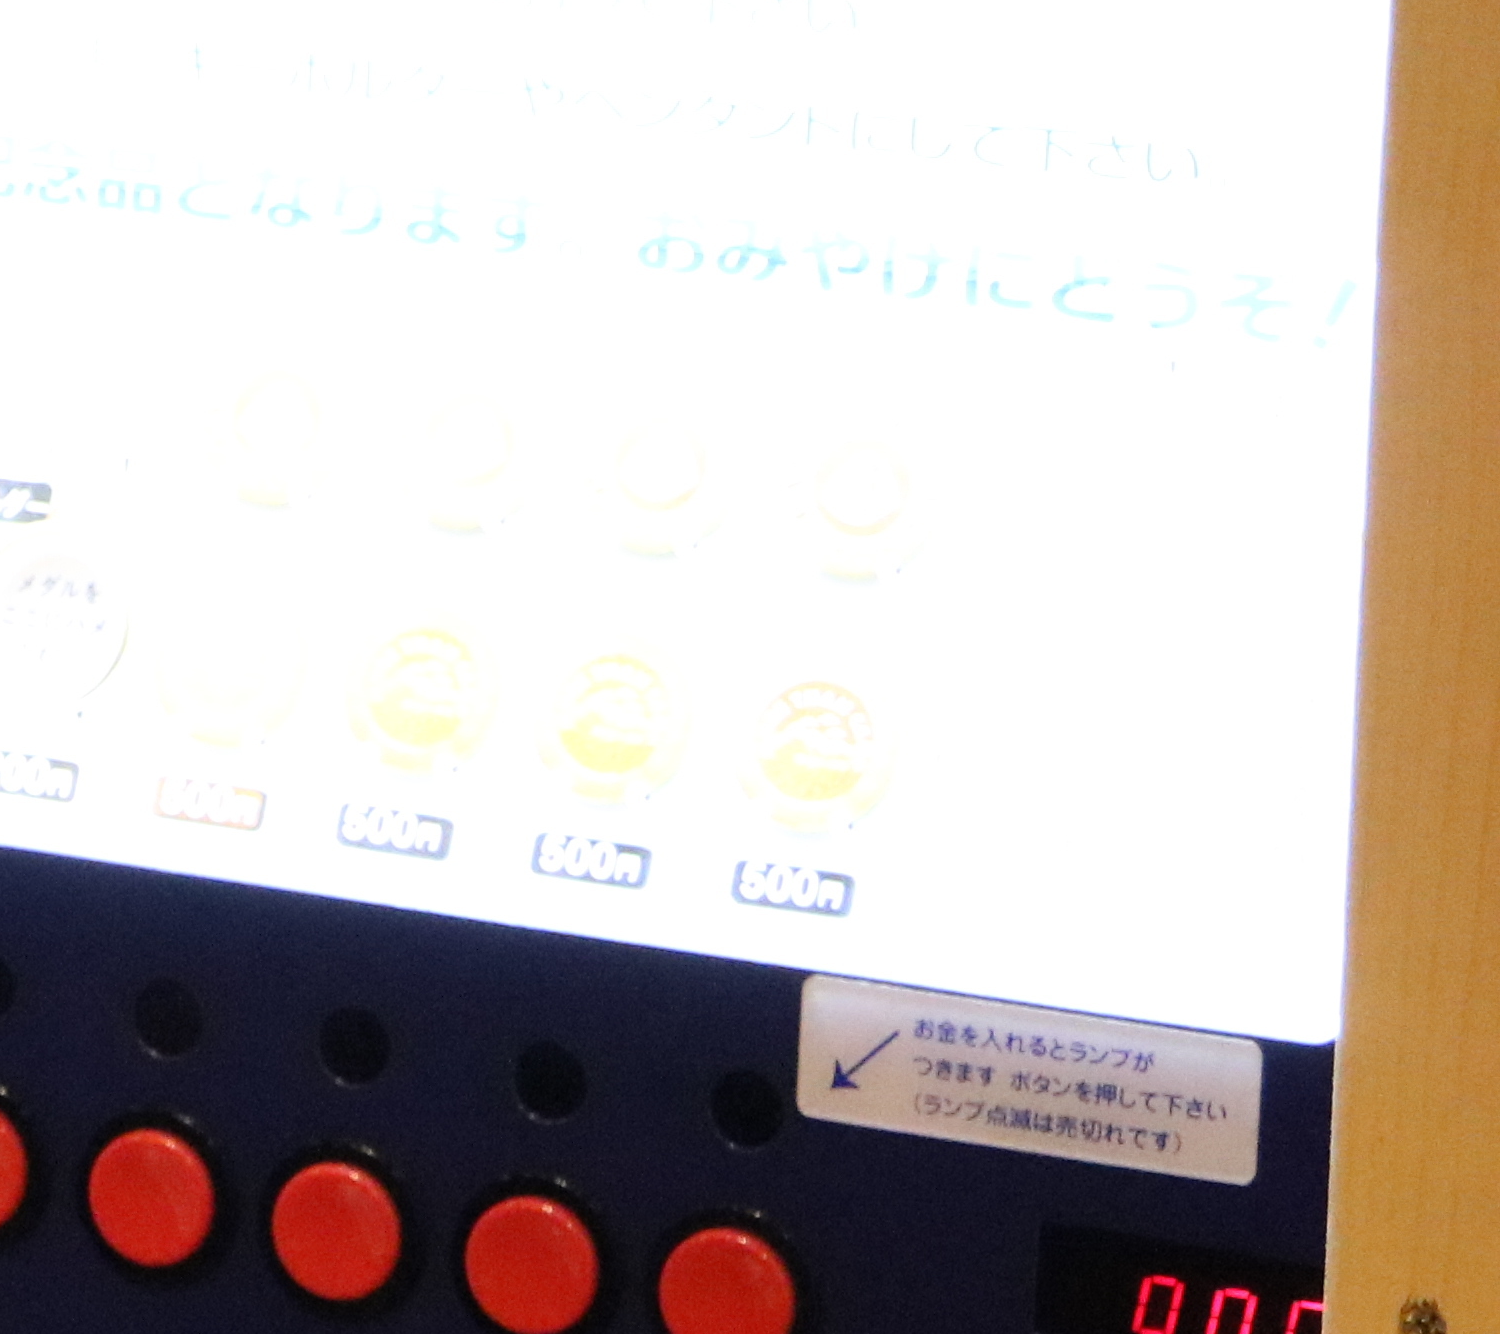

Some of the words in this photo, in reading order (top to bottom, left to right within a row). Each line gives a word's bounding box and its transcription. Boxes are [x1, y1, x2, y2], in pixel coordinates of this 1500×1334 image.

[912, 1018, 1155, 1074] お金を入れるとランプが
[911, 1055, 996, 1087] つきます
[1010, 1073, 1228, 1122] ボタンを押して下さい
